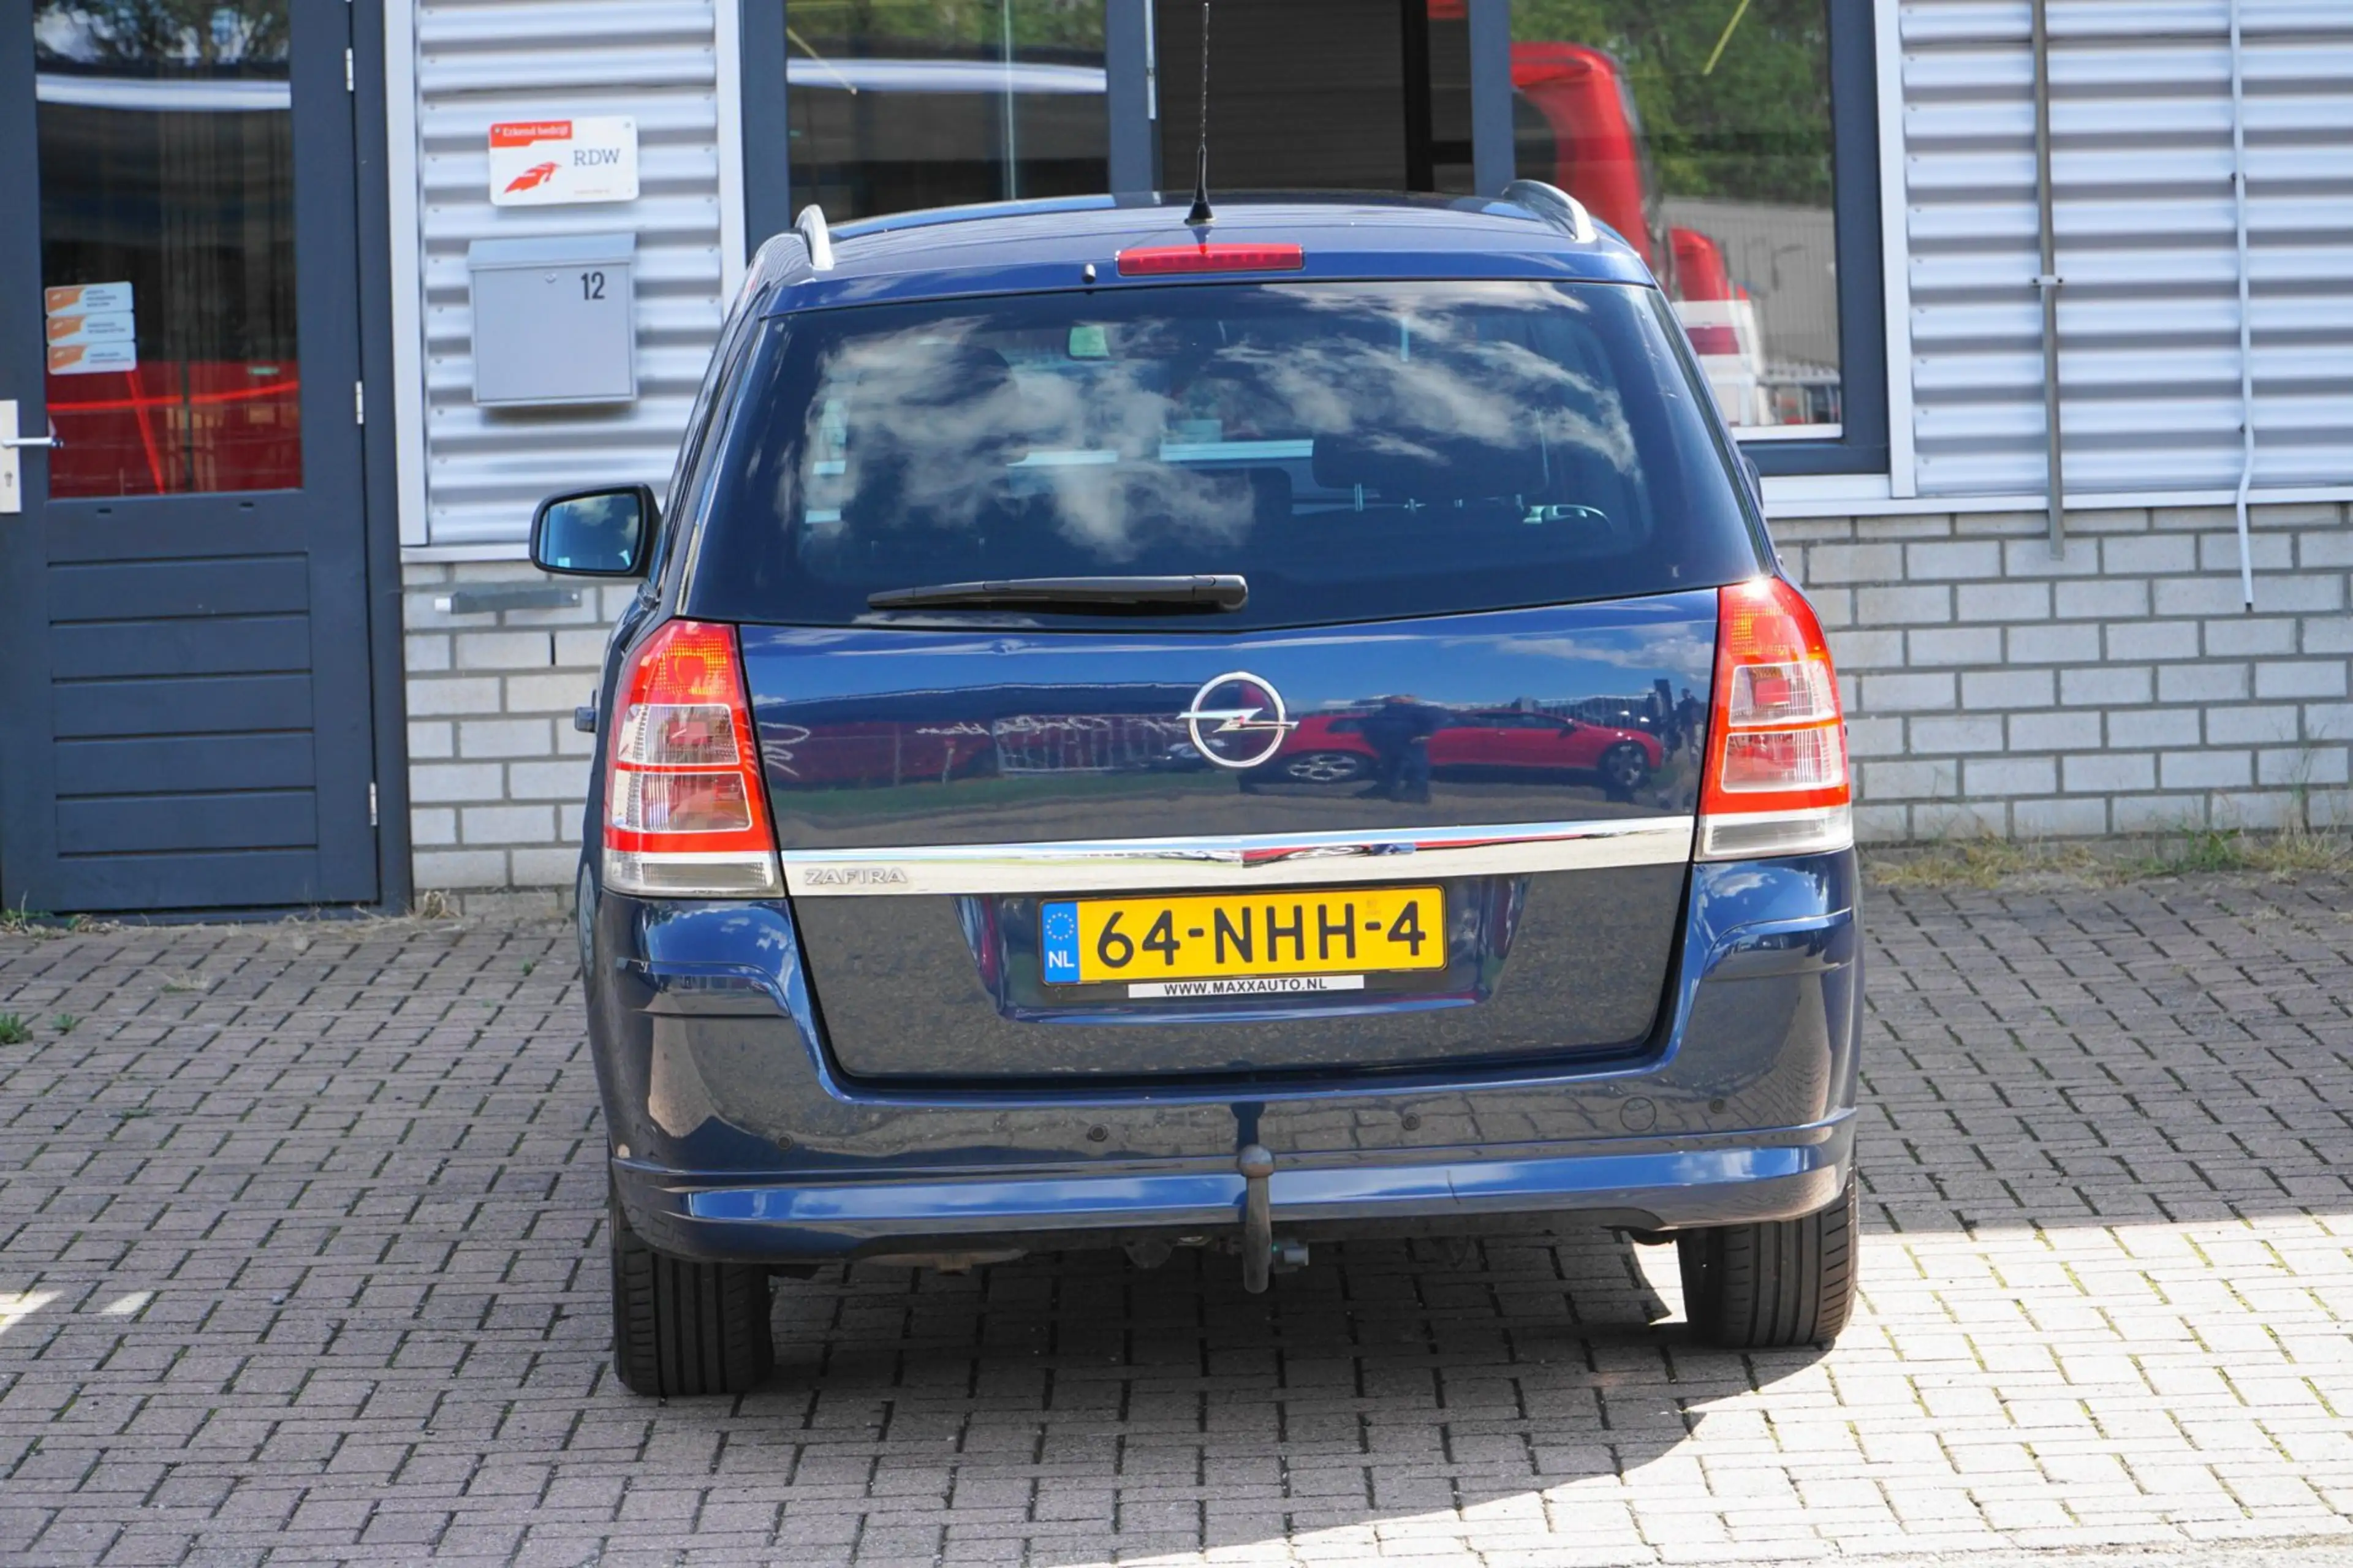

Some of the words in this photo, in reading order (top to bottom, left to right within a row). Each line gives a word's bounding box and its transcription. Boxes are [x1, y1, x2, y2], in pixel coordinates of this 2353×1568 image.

[573, 148, 620, 167] RDW
[580, 271, 605, 300] 12
[805, 868, 908, 885] ZAFIRA
[1097, 901, 1427, 969] 64-NHH-4
[1048, 950, 1075, 969] NL
[1164, 978, 1328, 995] WWW.MAXXAUTO.NL
